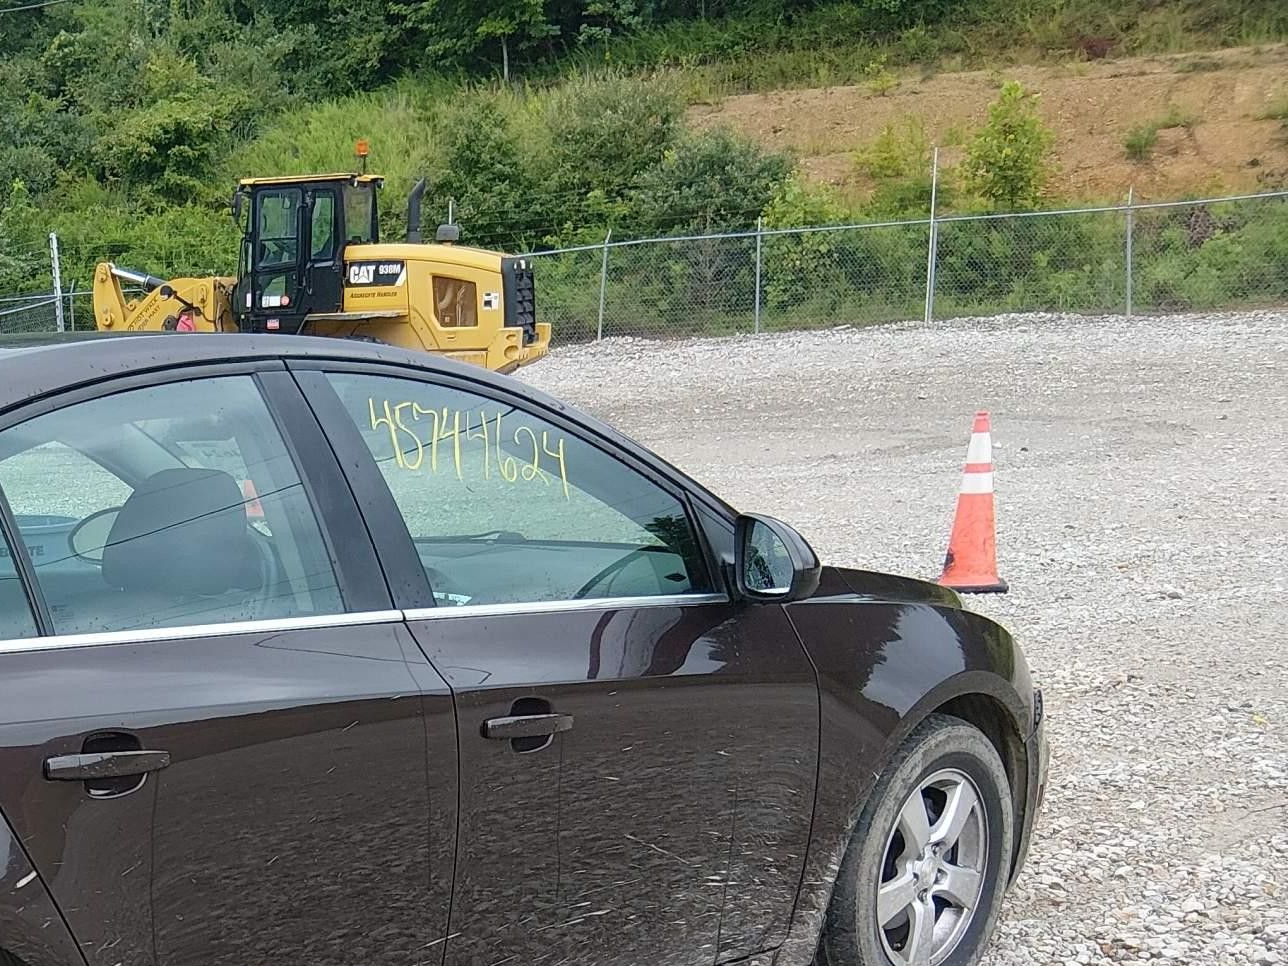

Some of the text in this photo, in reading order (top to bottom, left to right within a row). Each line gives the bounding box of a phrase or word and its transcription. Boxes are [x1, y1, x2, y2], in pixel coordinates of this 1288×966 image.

[350, 264, 401, 284] CAT 938M
[368, 397, 570, 501] 45744624
[0, 545, 45, 557] BTE
